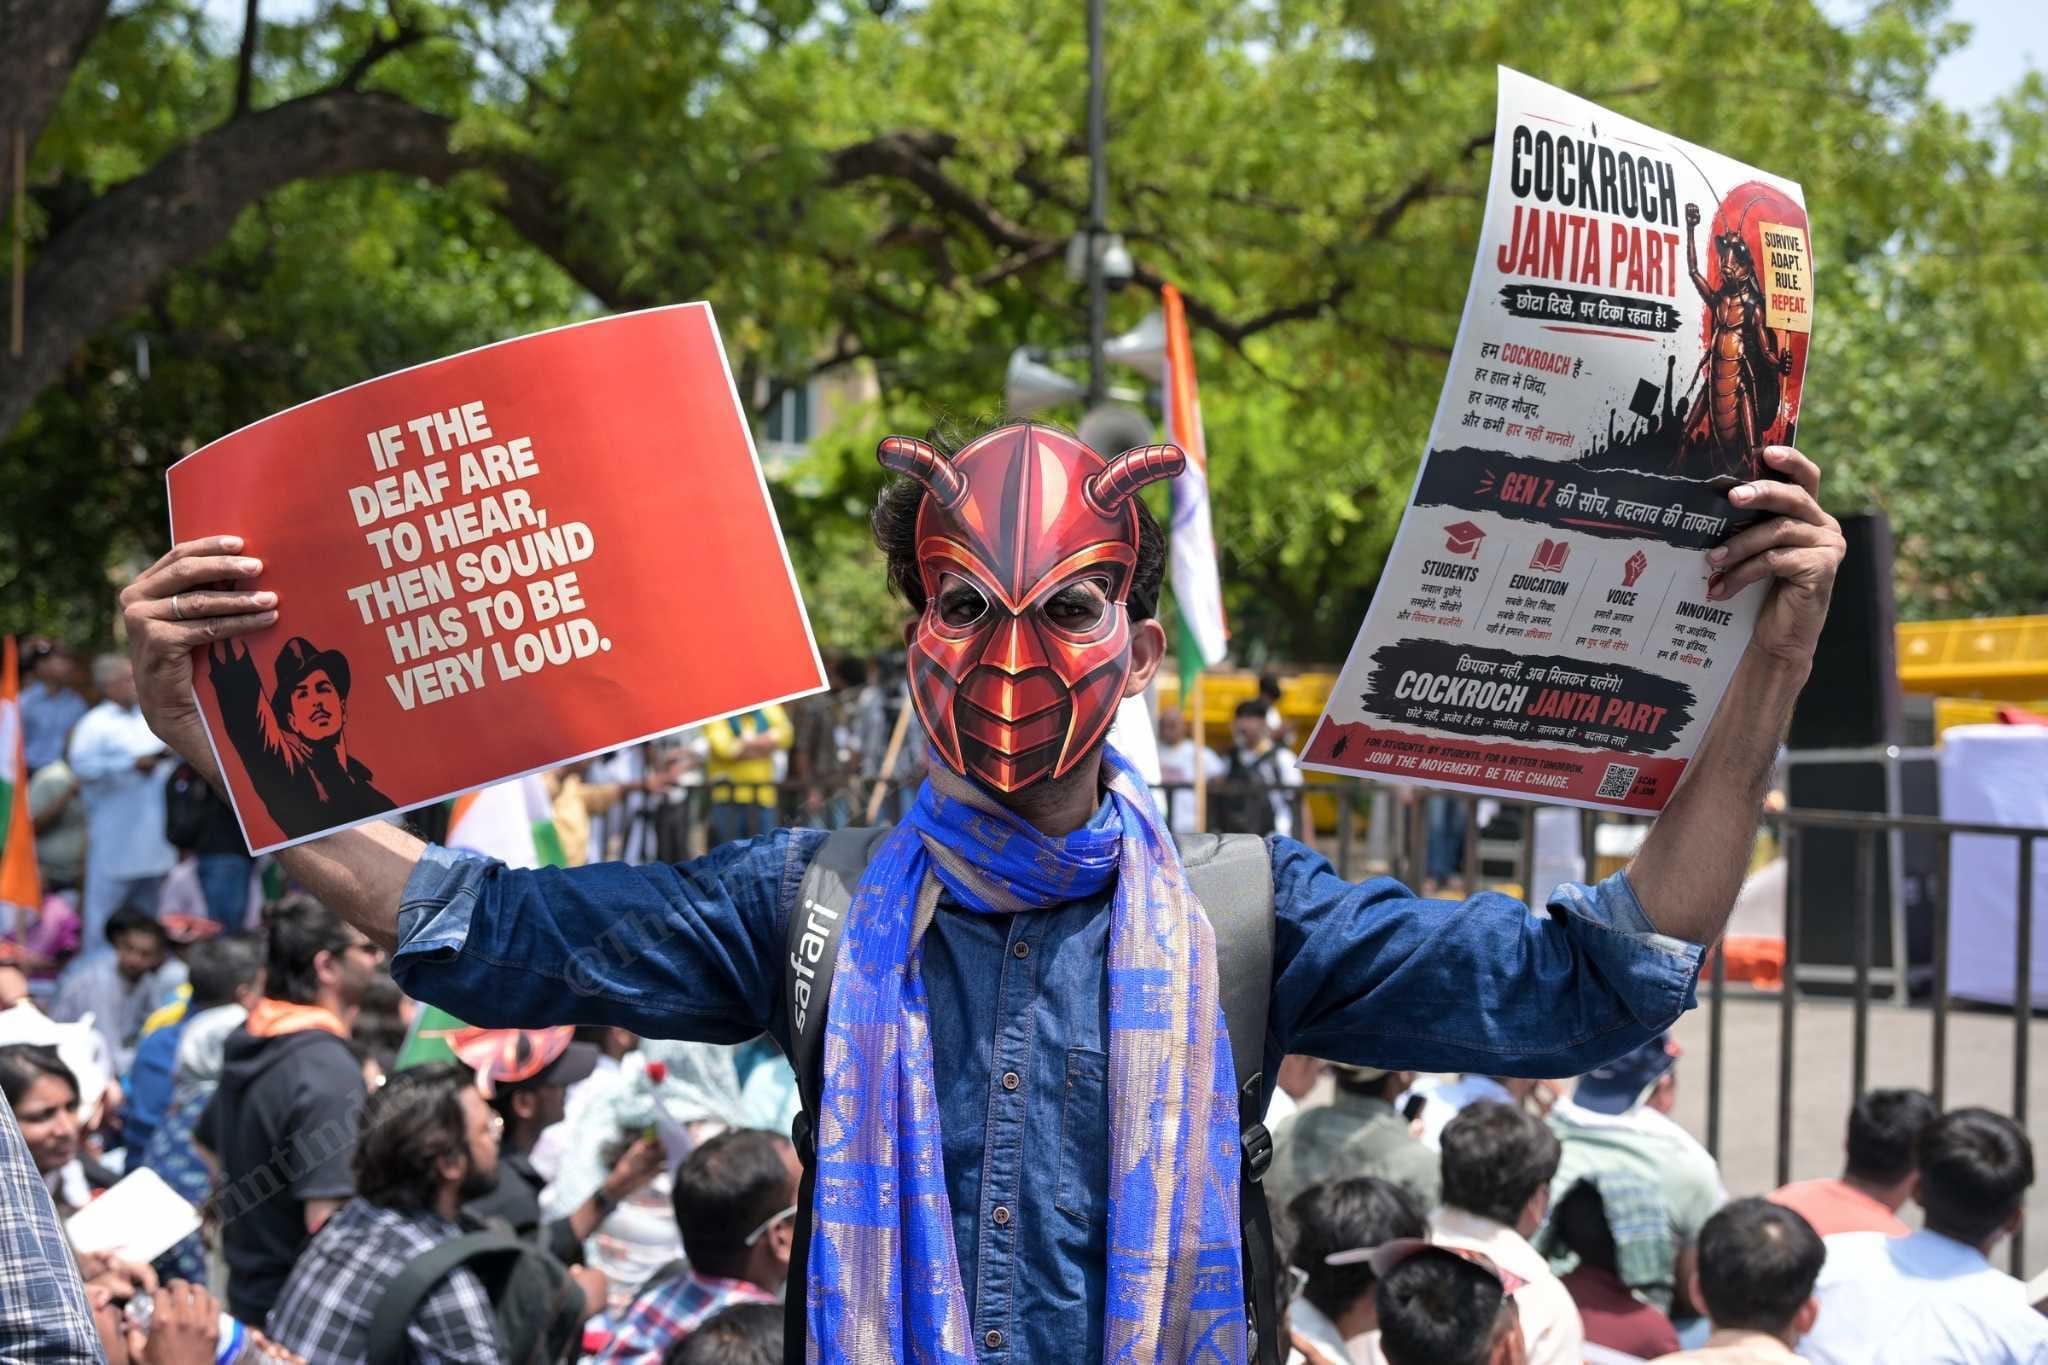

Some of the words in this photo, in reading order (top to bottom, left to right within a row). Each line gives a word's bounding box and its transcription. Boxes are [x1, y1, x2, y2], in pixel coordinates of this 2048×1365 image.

[1511, 125, 1679, 228] COCKROCH
[1497, 205, 1600, 286] JANTA
[1609, 222, 1680, 297] PART
[1764, 231, 1803, 252] SURVIVE.
[1771, 251, 1802, 271] ADAPT.
[1775, 271, 1801, 291] RULE.
[1516, 289, 1545, 311] छोटा
[1547, 292, 1576, 318] दिखे,
[1580, 301, 1595, 318] पर
[1598, 299, 1624, 321] टिका
[1627, 307, 1652, 325] रहता
[1655, 305, 1667, 328] है!
[1771, 293, 1807, 314] REPEAT.
[1474, 367, 1488, 381] हर
[1490, 371, 1510, 386] हाल
[1512, 372, 1521, 389] में
[1481, 342, 1500, 359] हम
[1501, 342, 1571, 376] COCKROACH
[1468, 390, 1482, 404] हर
[1484, 393, 1509, 411] जगह
[1511, 396, 1540, 419] मौजूद,
[366, 424, 405, 472] IF
[407, 400, 493, 457] THE
[1461, 410, 1481, 428] और
[1482, 417, 1505, 433] कभी
[1505, 422, 1523, 437] हार
[1525, 425, 1544, 441] नहीं
[1545, 430, 1575, 448] मानते!
[348, 460, 451, 527] DEAF
[459, 436, 540, 495] ARE
[1501, 471, 1538, 506] GEN
[1537, 479, 1556, 508] Z
[1555, 483, 1577, 509] की
[1578, 487, 1610, 519] सोच,
[1614, 499, 1662, 525] बदलाव
[1661, 503, 1683, 527] की
[366, 522, 422, 569] TO
[424, 488, 547, 553] HEAR,
[347, 560, 455, 625] THEN
[456, 521, 595, 593] SOUND
[1421, 559, 1479, 582] STUDENTS
[1508, 574, 1569, 596] EDUCATION
[1606, 588, 1639, 607] VOICE
[1675, 600, 1733, 627] INNOVATE
[385, 607, 468, 665] HAS
[466, 590, 524, 638] TO
[527, 571, 586, 622] BE
[385, 647, 486, 711] VERY
[491, 618, 612, 681] LOUD.
[1456, 653, 1499, 675] छिपकर
[1500, 660, 1524, 681] नहीं,
[1525, 667, 1546, 682] अब
[1547, 665, 1588, 687] मिलकर
[1589, 672, 1624, 693] चलेंगे!
[1394, 670, 1530, 713] COCKROCH
[1527, 688, 1603, 724] JANTA
[1601, 698, 1668, 735] PART
[1364, 751, 1394, 765] JOIN
[1395, 754, 1419, 769] THE
[1418, 758, 1482, 777] MOVEMENT.
[1485, 767, 1502, 780] BE
[1503, 769, 1525, 783] THE
[1525, 771, 1570, 789] CHANGE.
[790, 899, 839, 1035] safari
